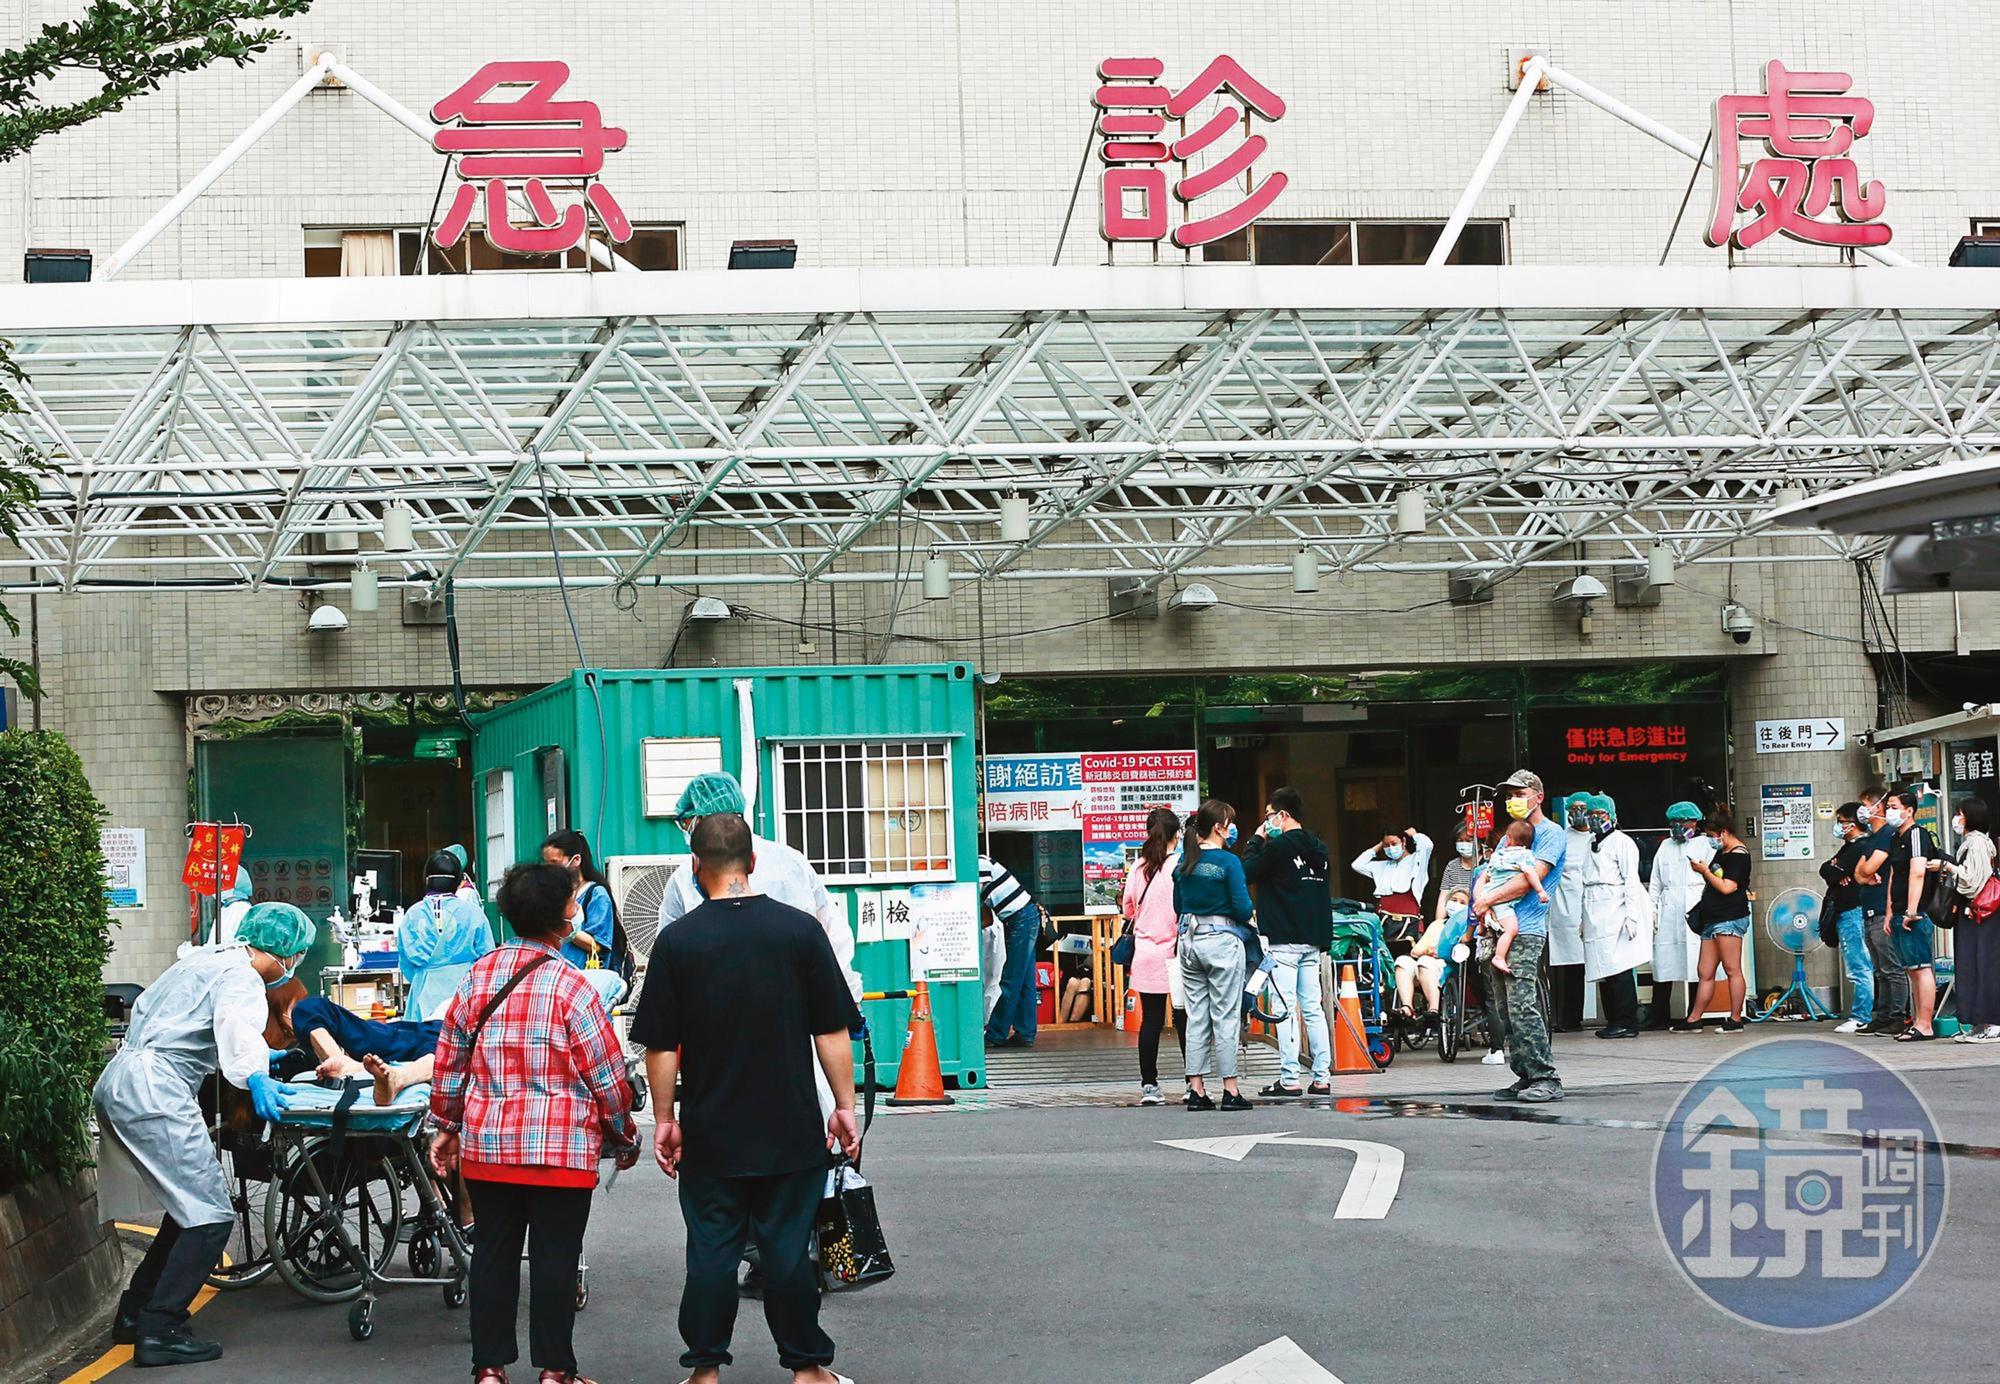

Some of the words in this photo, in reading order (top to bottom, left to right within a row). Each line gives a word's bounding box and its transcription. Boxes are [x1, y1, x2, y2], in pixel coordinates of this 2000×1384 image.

[1566, 726, 1686, 749] 僅供急診進出
[1759, 725, 1812, 741] 往後門
[1791, 741, 1812, 749] Entry
[1084, 757, 1136, 769] Covid-19
[1139, 756, 1162, 767] PCR
[1165, 755, 1192, 767] TEST
[1568, 753, 1595, 765] Only
[1598, 752, 1615, 763] for
[1619, 751, 1687, 763] Emergency
[1954, 750, 1995, 781] 警衛室
[988, 762, 1081, 788] 謝絕訪客
[1085, 769, 1193, 781] 新冠肺炎自費篩檢已預約者
[862, 899, 910, 927] 篩檢
